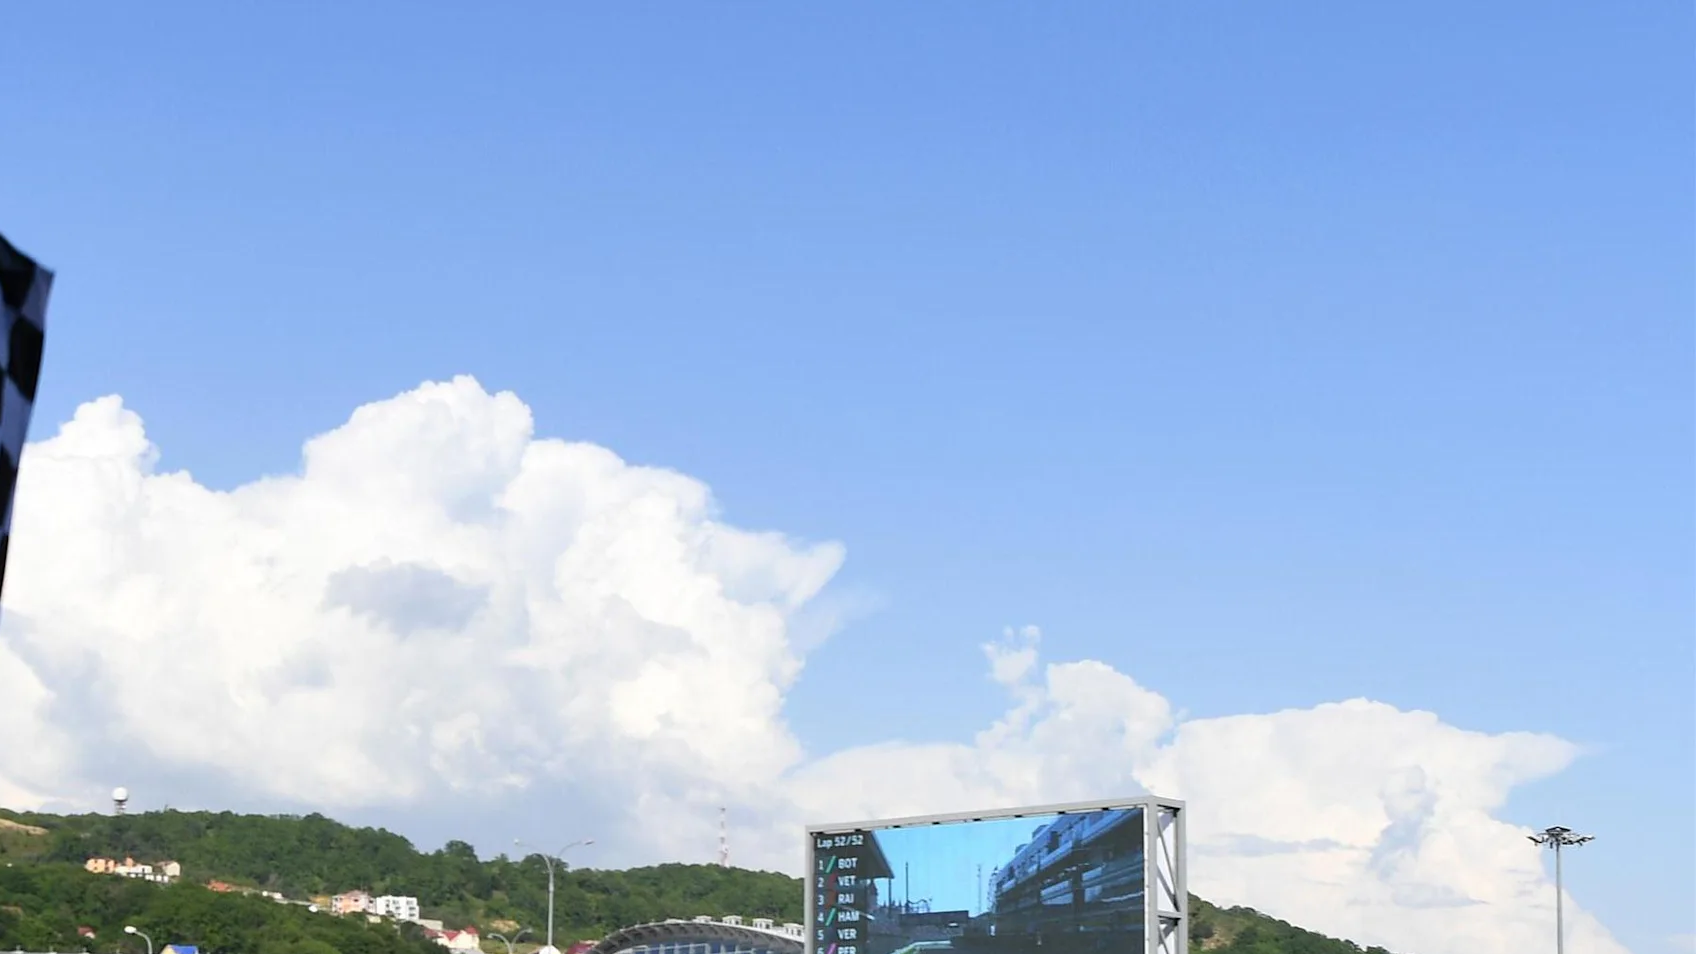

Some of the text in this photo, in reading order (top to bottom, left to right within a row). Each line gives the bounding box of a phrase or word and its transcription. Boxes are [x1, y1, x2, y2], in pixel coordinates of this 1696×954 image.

[817, 835, 863, 849] Lap 52/52
[818, 858, 858, 871] 1 BOT
[817, 875, 856, 887] 2 VET
[818, 893, 854, 905] 3 RAI
[817, 911, 859, 922] 4 HAM
[817, 929, 857, 940] 5 VER
